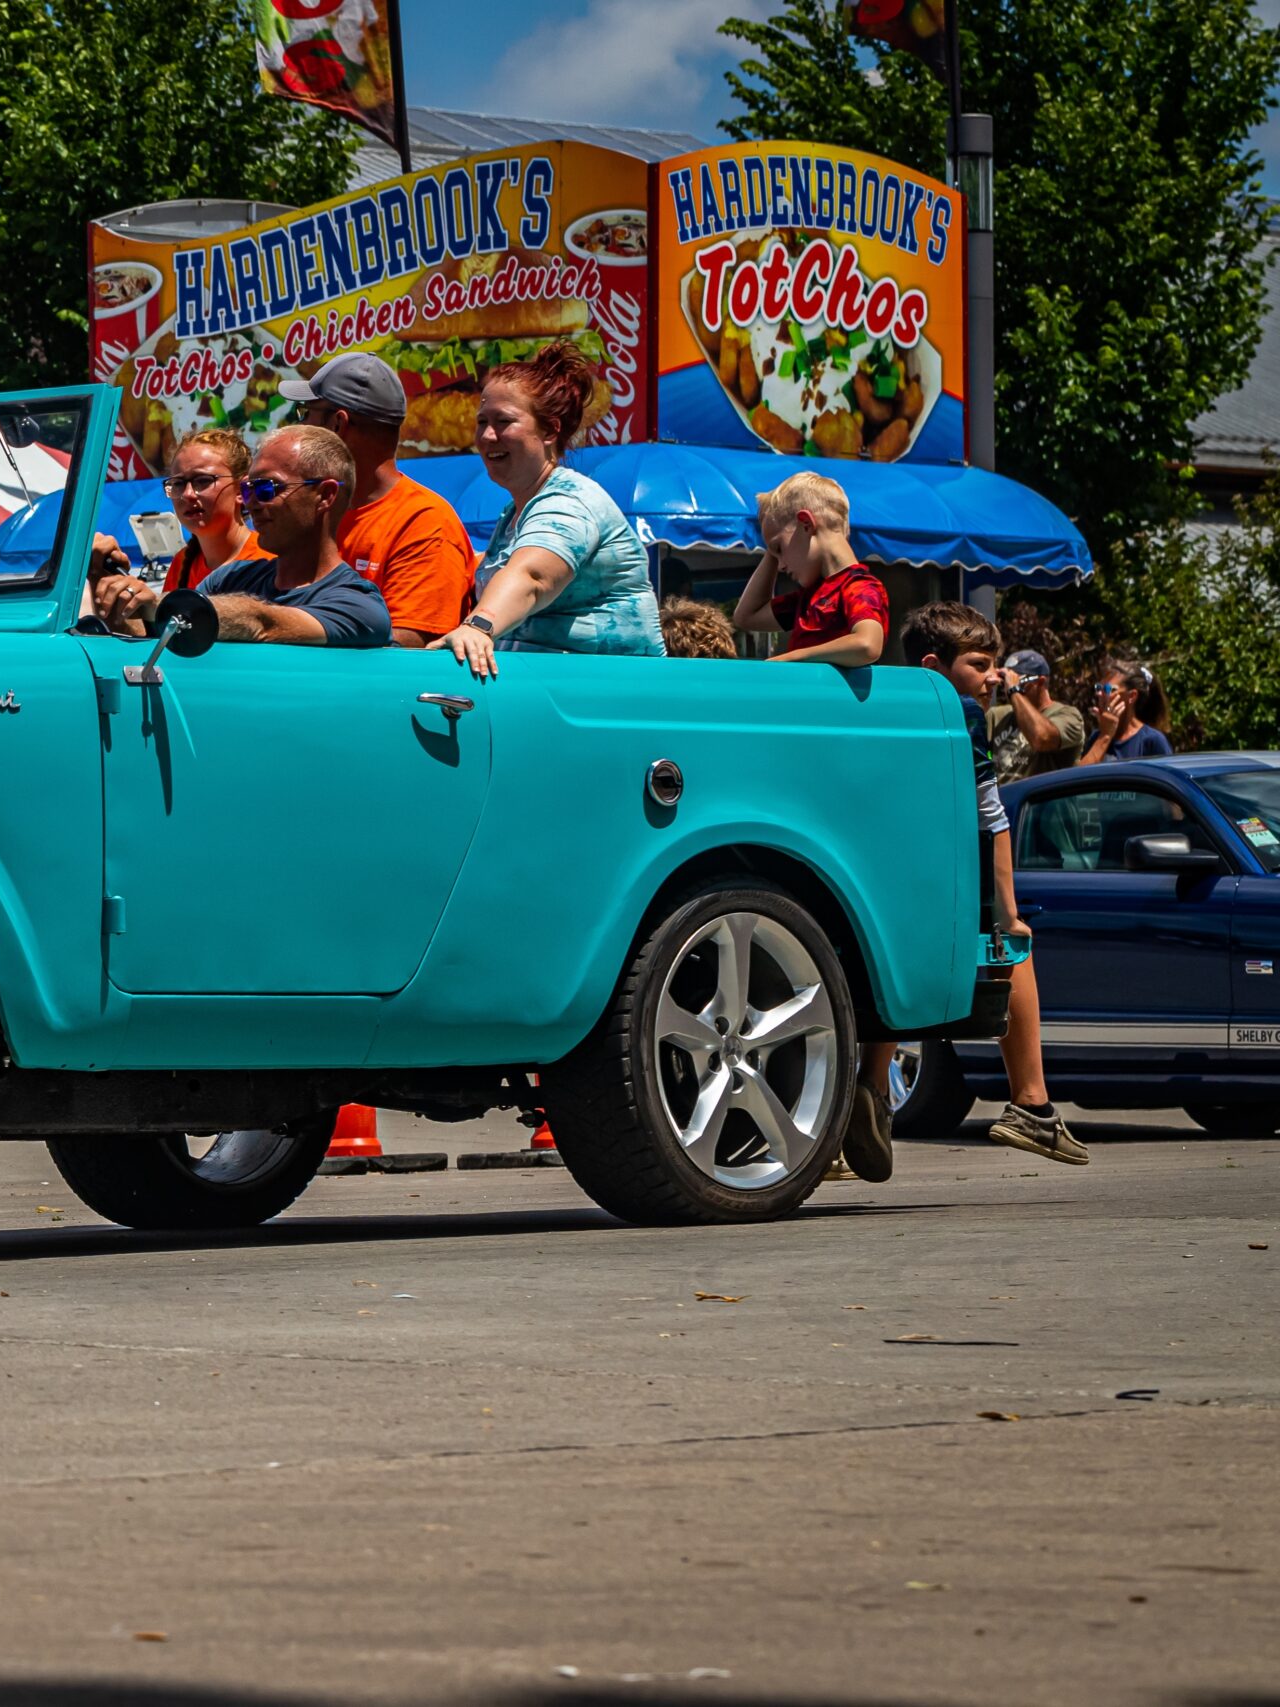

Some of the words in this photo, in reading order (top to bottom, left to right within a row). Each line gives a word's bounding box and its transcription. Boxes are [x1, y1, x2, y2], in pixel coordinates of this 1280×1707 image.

[174, 157, 554, 340] HARDENBROOK'S
[668, 155, 952, 266] HARDENBROOK'S
[132, 348, 253, 399] TotChos
[282, 295, 417, 367] Chicken
[422, 255, 602, 321] Sandwich
[695, 239, 928, 349] TotChos
[1236, 1029, 1273, 1043] SHELBY
